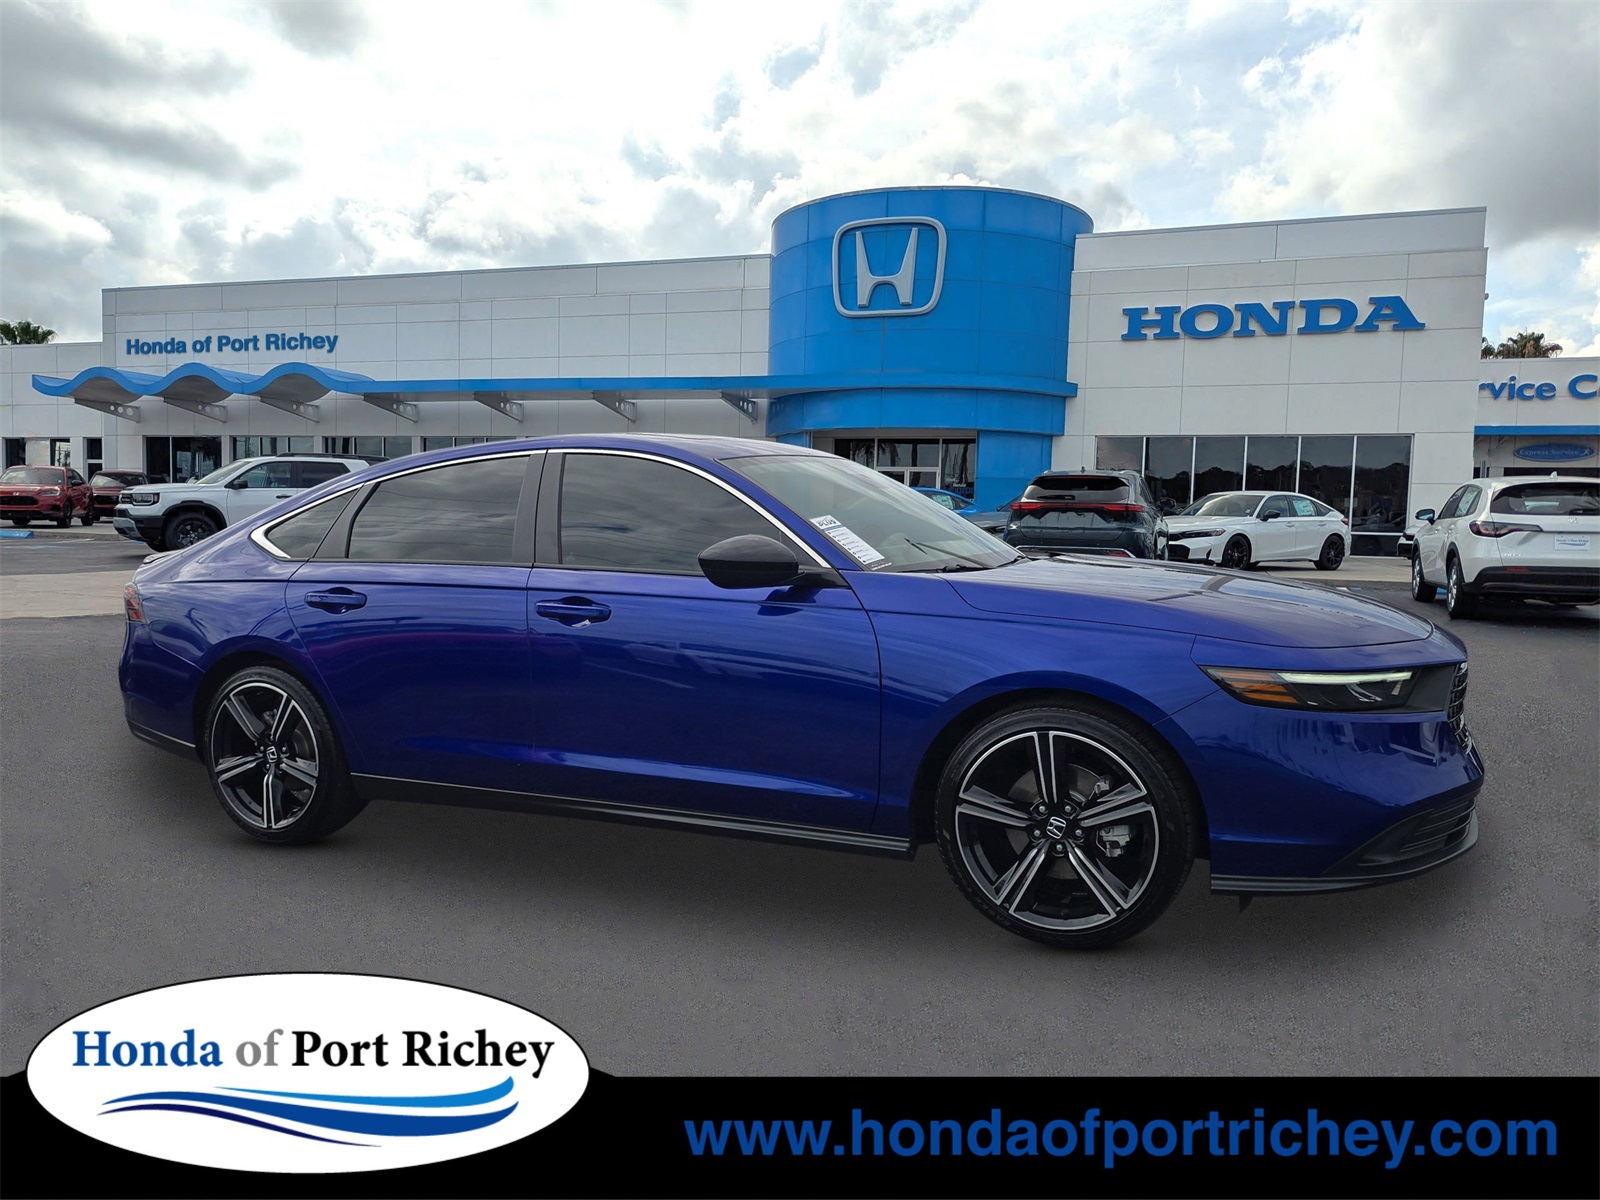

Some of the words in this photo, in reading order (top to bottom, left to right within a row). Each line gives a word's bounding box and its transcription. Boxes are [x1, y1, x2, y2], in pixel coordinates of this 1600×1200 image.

[1121, 295, 1426, 341] HONDA
[126, 337, 187, 355] Honda
[191, 336, 213, 353] of
[217, 334, 260, 352] Port
[265, 332, 339, 353] Richey
[1568, 373, 1600, 400] C
[1519, 448, 1549, 456] Express
